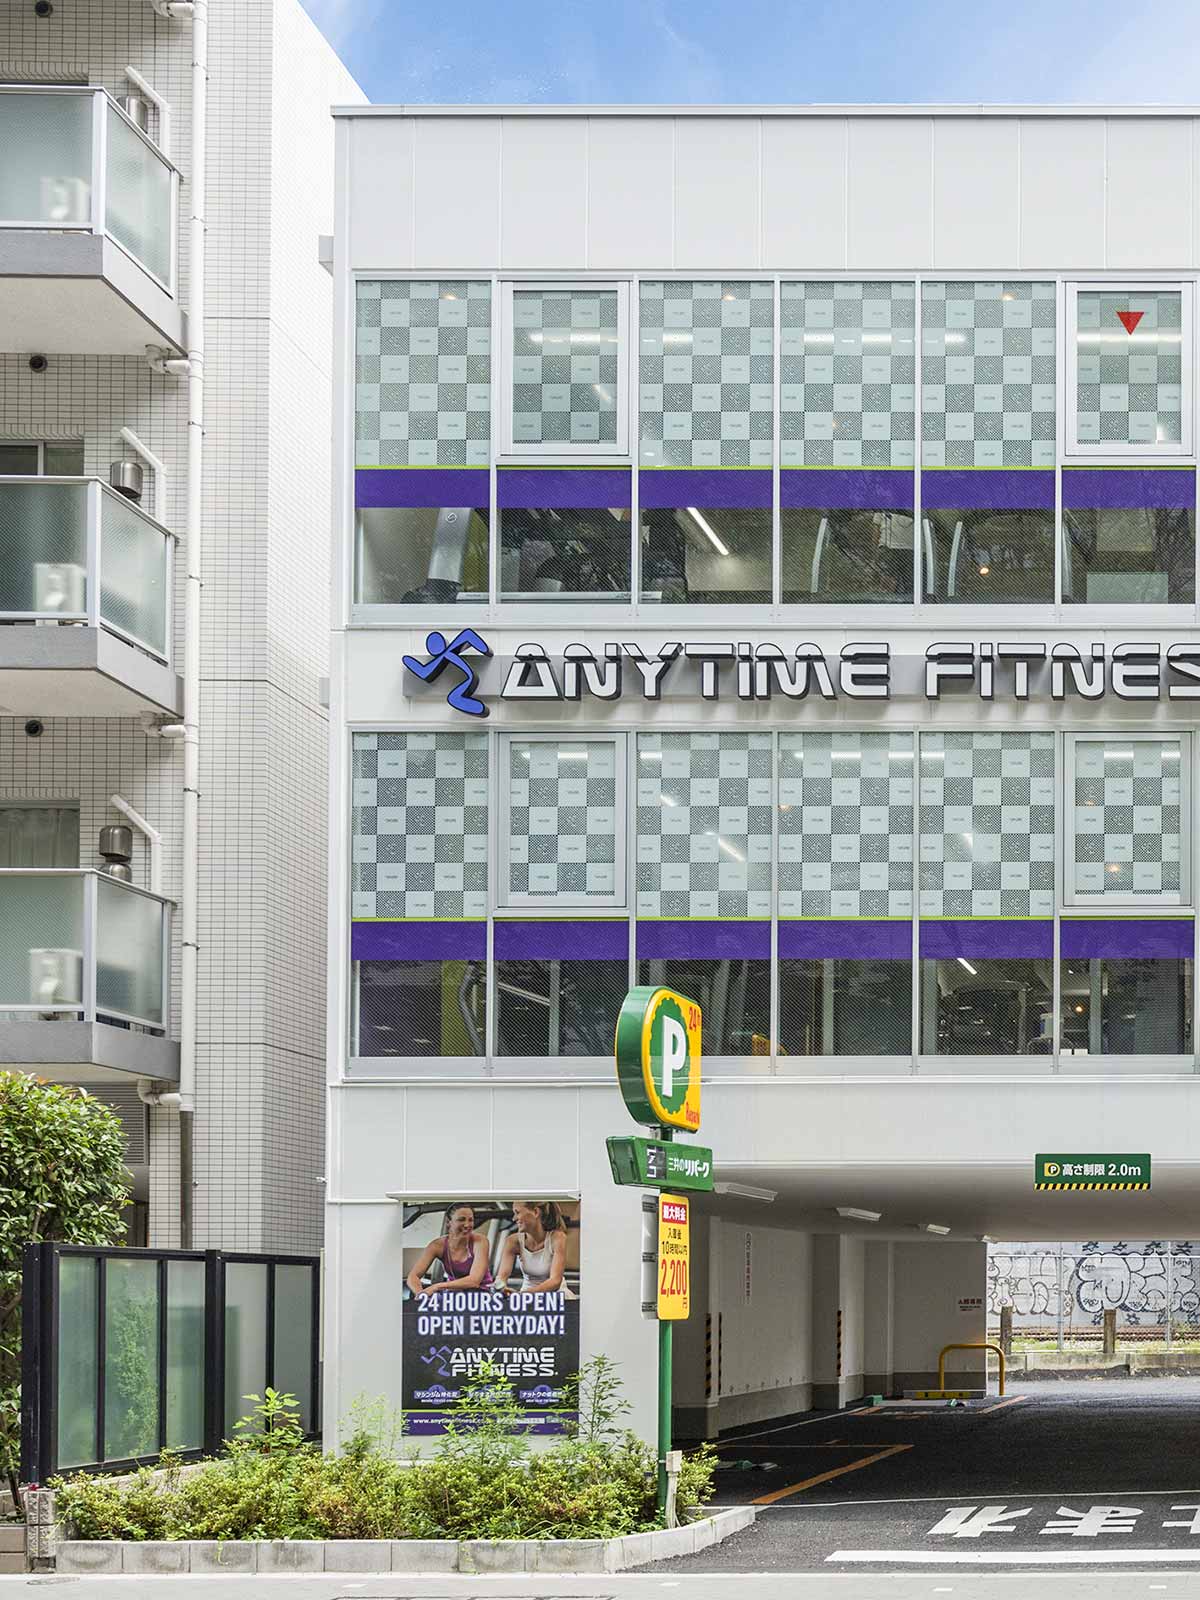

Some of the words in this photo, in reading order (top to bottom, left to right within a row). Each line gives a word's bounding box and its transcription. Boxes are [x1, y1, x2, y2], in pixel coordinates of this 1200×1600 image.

[500, 642, 891, 700] ANYTIME
[662, 1014, 687, 1098] P
[668, 1156, 710, 1179] 三井のリパーク
[1062, 1163, 1106, 1177] 高さ制限
[1108, 1163, 1142, 1177] 2.0m
[660, 1259, 687, 1298] 2,200
[443, 1292, 504, 1312] HOURS
[509, 1292, 566, 1312] OPEN!
[417, 1315, 465, 1336] OPEN
[469, 1315, 566, 1336] EVERYDAY!
[450, 1347, 555, 1363] ANYTIME
